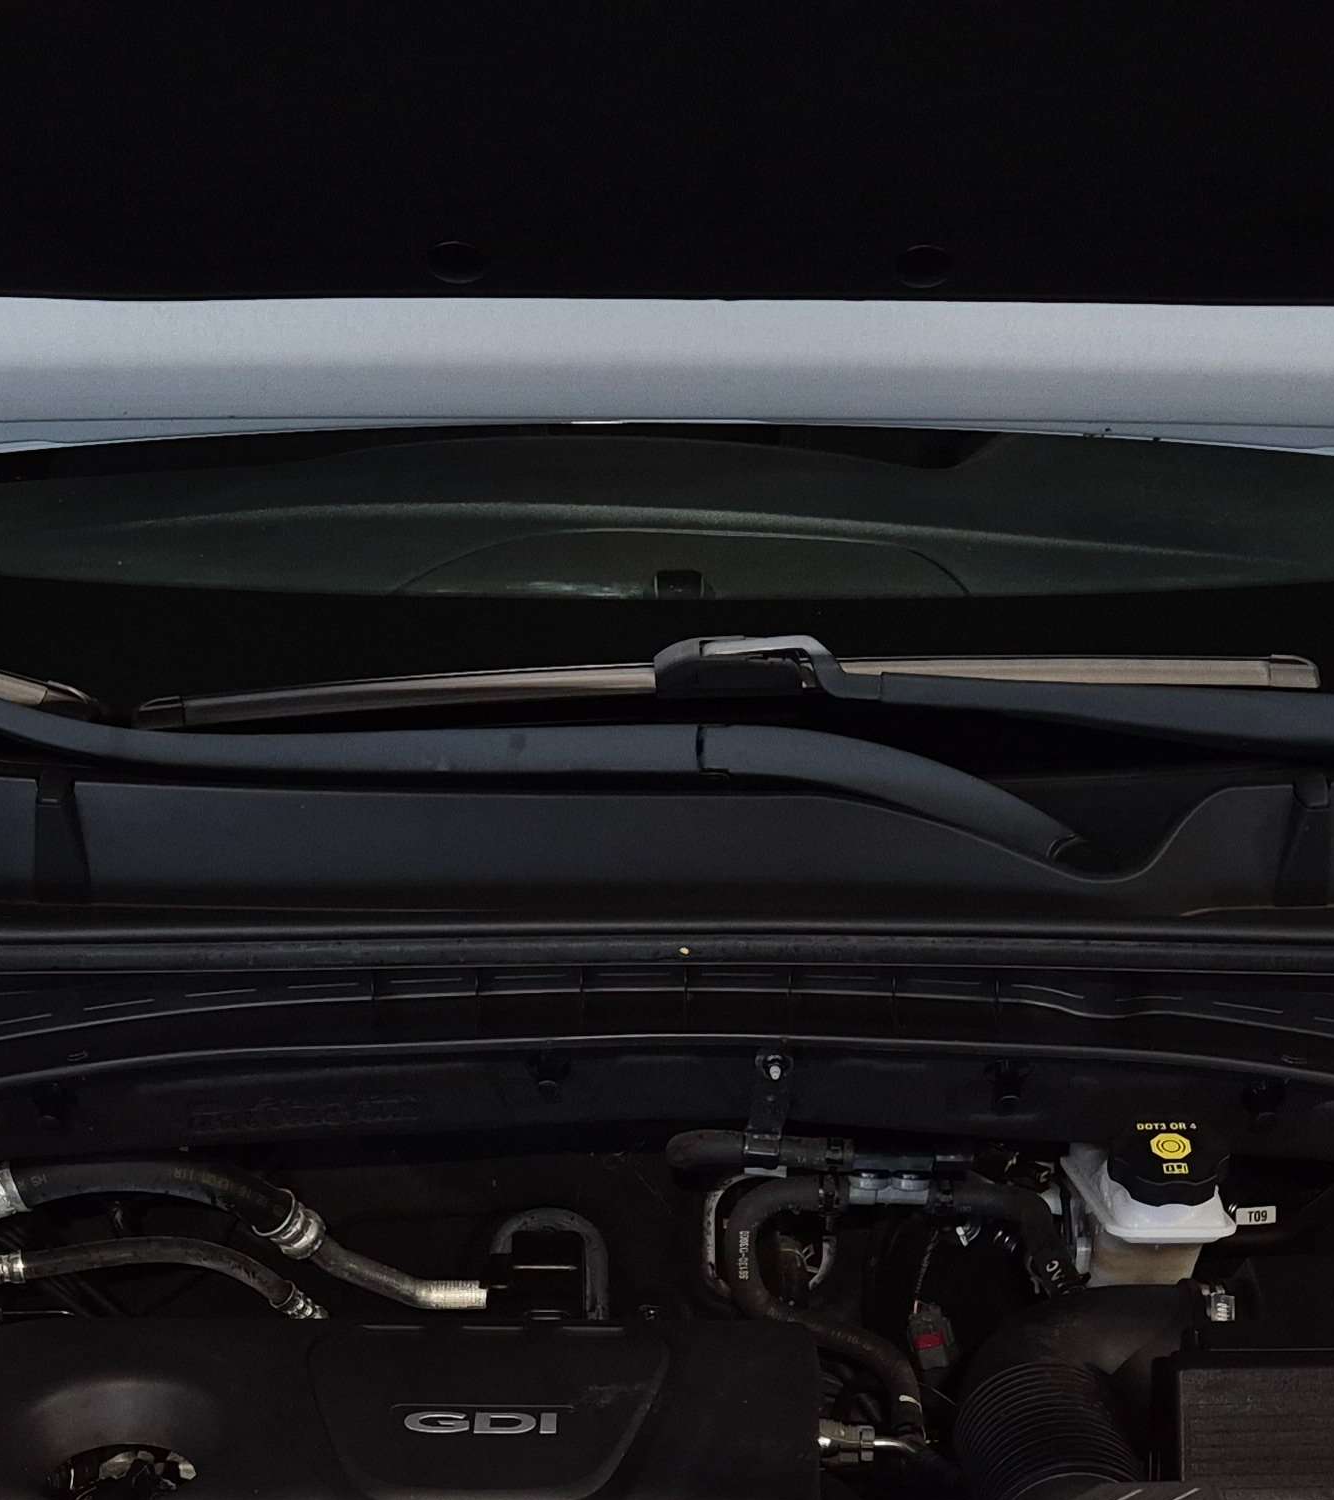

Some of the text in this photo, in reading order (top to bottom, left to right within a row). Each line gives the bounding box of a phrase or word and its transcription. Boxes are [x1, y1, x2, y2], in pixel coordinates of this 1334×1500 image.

[1136, 1122, 1167, 1131] DOT3
[1169, 1121, 1187, 1131] OR
[1247, 1210, 1268, 1222] T09
[403, 1411, 558, 1435] GDI
